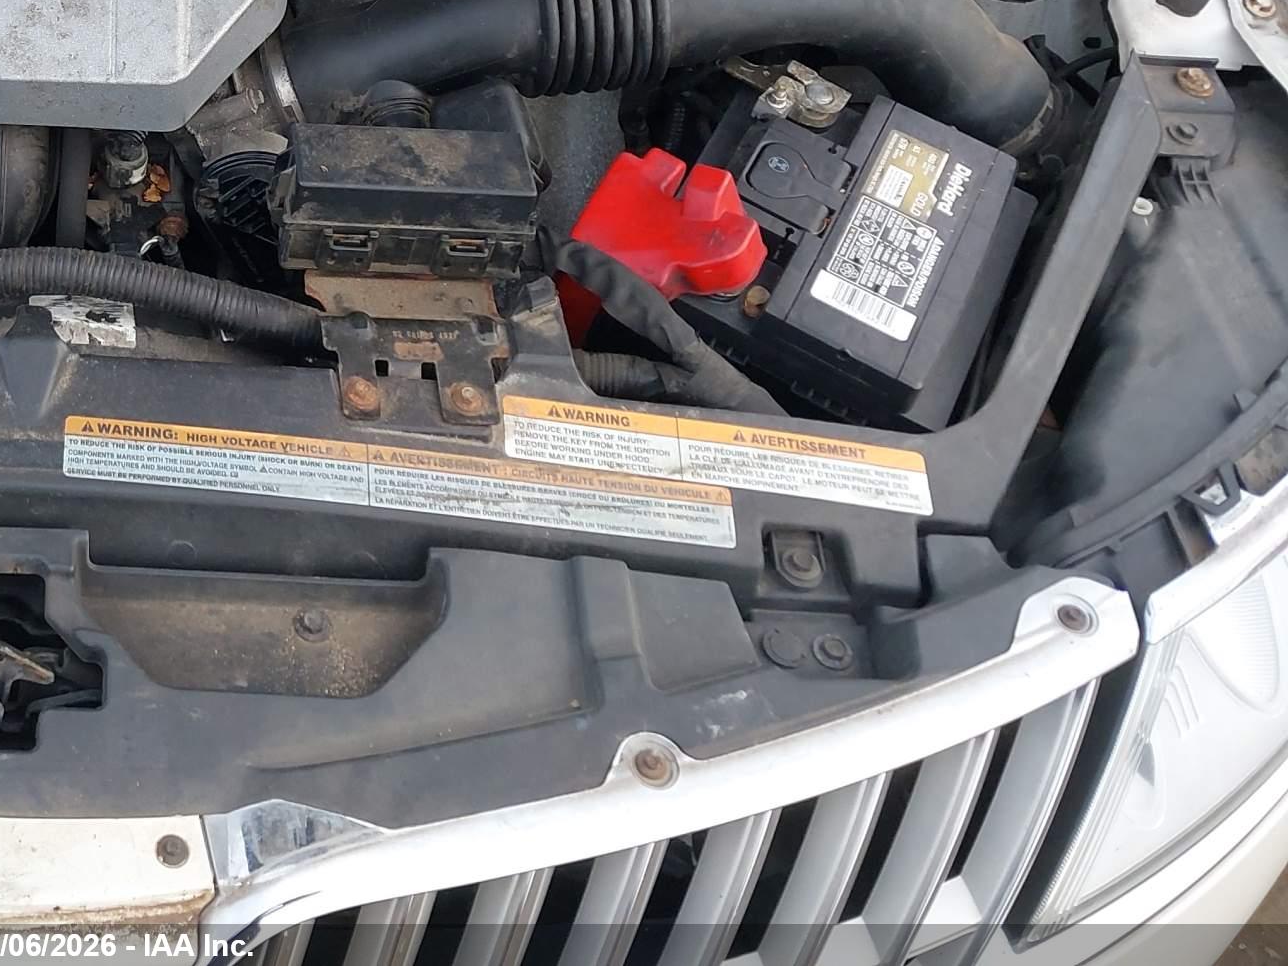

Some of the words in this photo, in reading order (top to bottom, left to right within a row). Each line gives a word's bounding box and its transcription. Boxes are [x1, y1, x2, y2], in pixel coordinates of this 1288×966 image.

[936, 162, 973, 217] DieHard
[910, 192, 929, 217] GOLD
[907, 245, 942, 309] DANGER/POISON
[563, 407, 631, 427] WARNING
[97, 423, 179, 440] WARNING:
[187, 432, 217, 444] HIGH
[222, 437, 276, 449] VOLTAGE
[281, 442, 334, 455] VEHICLE
[514, 421, 525, 429] TO
[527, 423, 562, 433] REDUCE
[564, 427, 580, 435] THE
[582, 429, 601, 438] RISK
[81, 439, 109, 448] REDUCE
[128, 443, 145, 451] RISK
[159, 446, 193, 456] POSSIBLE
[196, 449, 227, 459] SERIOUS
[229, 452, 256, 462] INJURY
[514, 430, 549, 441] REMOVE
[552, 434, 568, 443] THE
[570, 437, 587, 446] KEY
[589, 439, 612, 449] FROM
[615, 443, 632, 452] THE
[634, 445, 671, 457] IGNITION
[514, 439, 548, 450] BEFORE
[551, 444, 592, 456] WORKING
[594, 449, 623, 459] UNDER
[688, 444, 712, 453] POUR
[750, 433, 866, 459] AVERTISSEMENT
[67, 449, 115, 459] COMPONENTS
[116, 453, 145, 462] MARKED
[165, 457, 177, 465] THE
[229, 463, 257, 472] SYMBOL
[268, 467, 298, 476] CONTAIN
[299, 470, 316, 478] HIGH
[317, 472, 347, 481] VOLTAGE
[67, 457, 84, 465] HIGH
[86, 459, 139, 469] TEMPERATURES
[141, 463, 155, 471] AND
[157, 464, 184, 473] SHOULD
[515, 448, 546, 458] ENGINE
[548, 453, 566, 461] MAY
[568, 455, 595, 465] START
[67, 468, 96, 476] SERVICE
[128, 473, 171, 482] PERFORMED
[183, 477, 218, 487] QUALIFIED
[220, 480, 261, 491] PERSONNEL
[374, 468, 394, 476] POUR
[388, 452, 502, 475] AVERTISSEMENT
[562, 475, 593, 487] HAUTE
[598, 479, 642, 493] TENSION
[644, 484, 658, 493] DU
